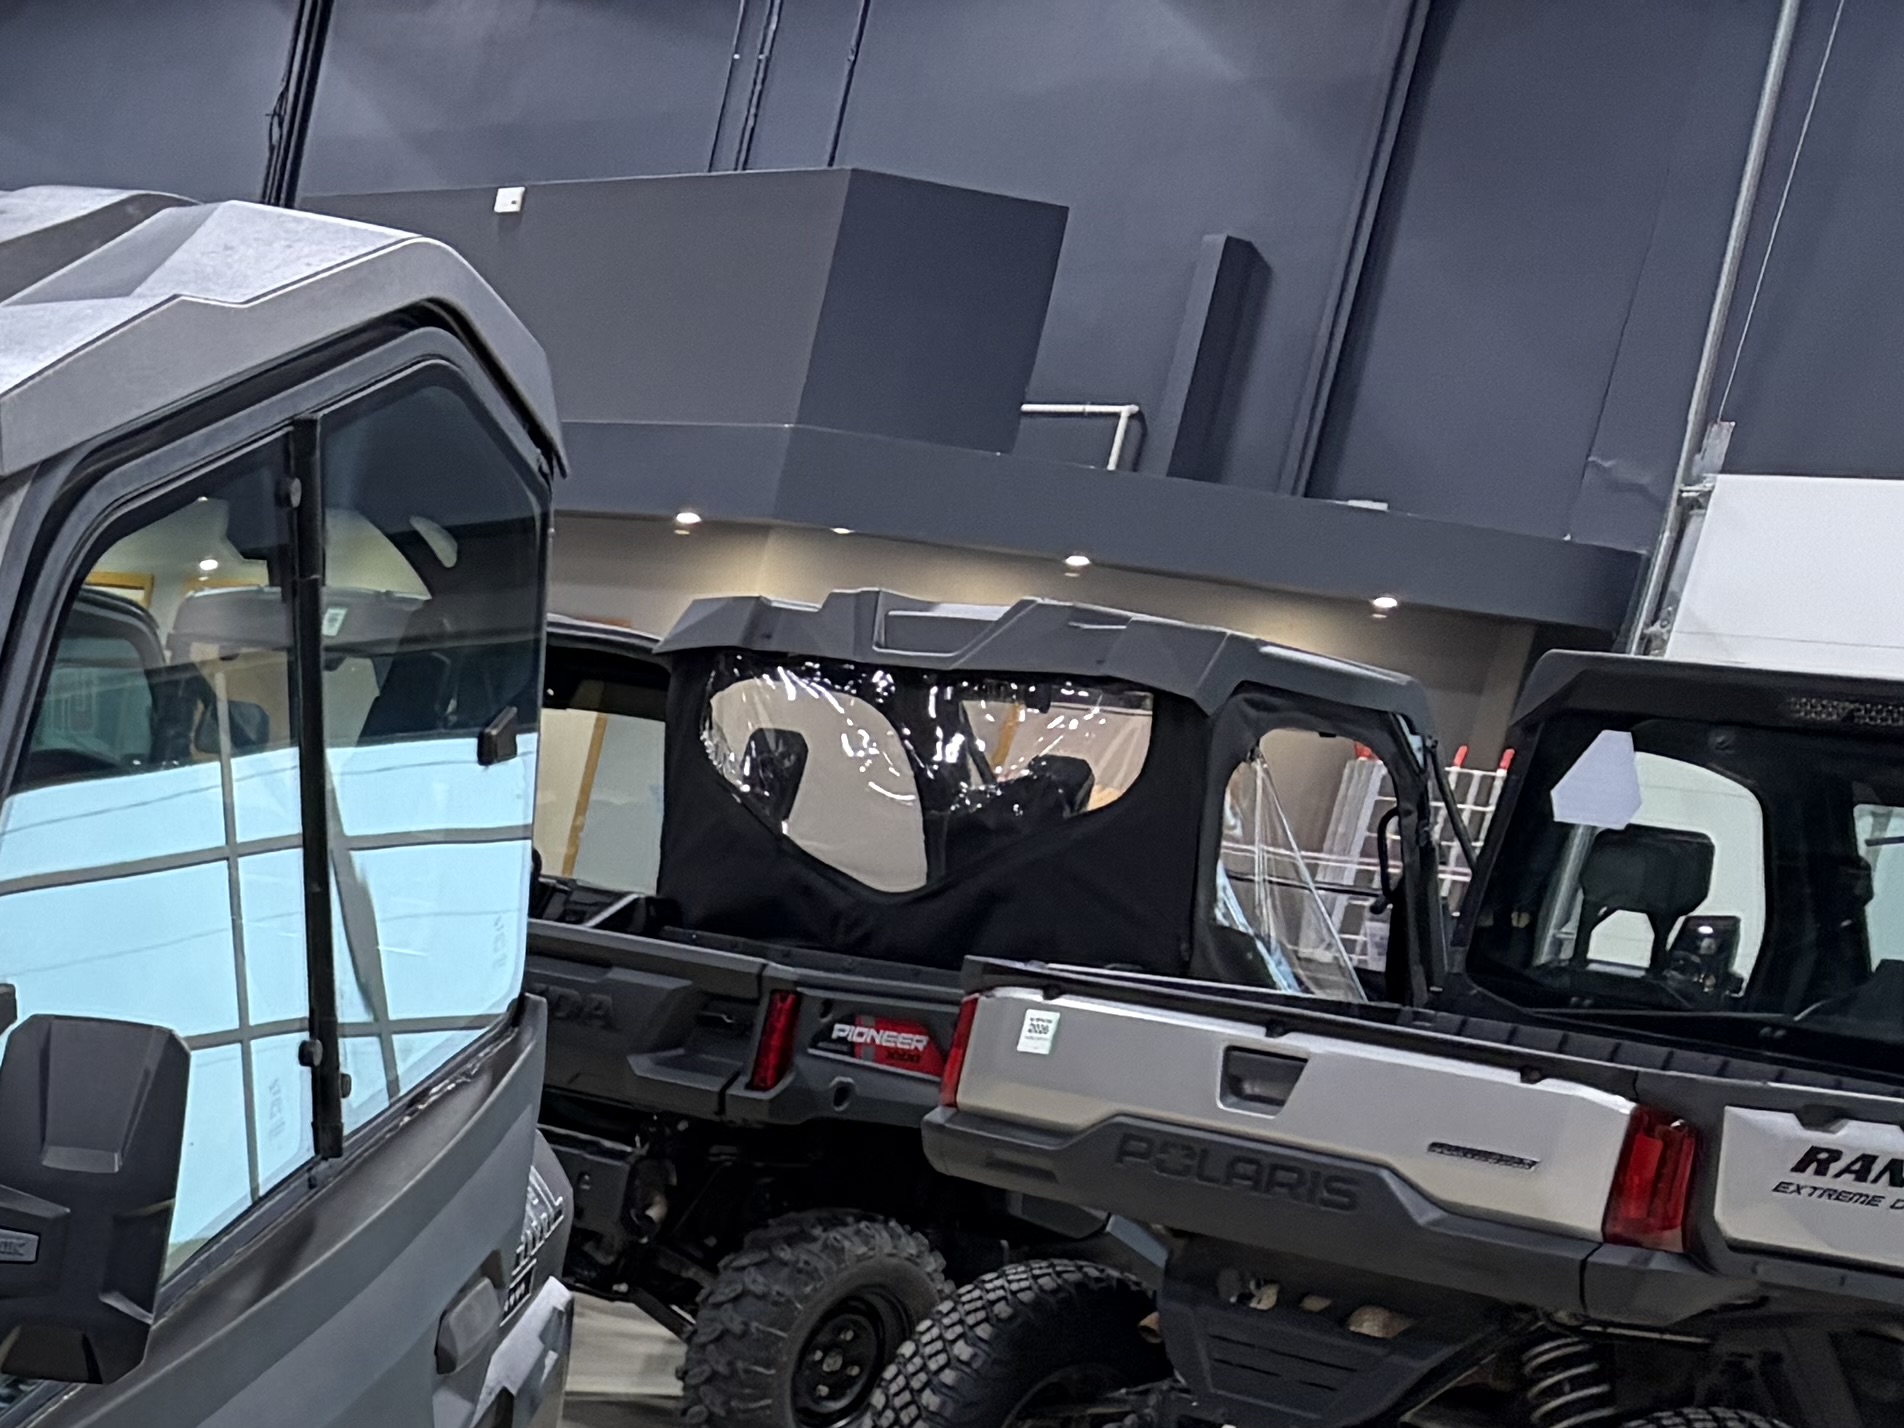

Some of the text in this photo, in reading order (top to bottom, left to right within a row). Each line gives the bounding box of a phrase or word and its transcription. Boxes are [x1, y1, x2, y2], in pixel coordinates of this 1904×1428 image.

[830, 1022, 930, 1052] PIONEER
[1114, 1131, 1361, 1214] POLARIS
[1789, 1144, 1904, 1189] RAN
[1771, 1180, 1886, 1207] EXTREME
